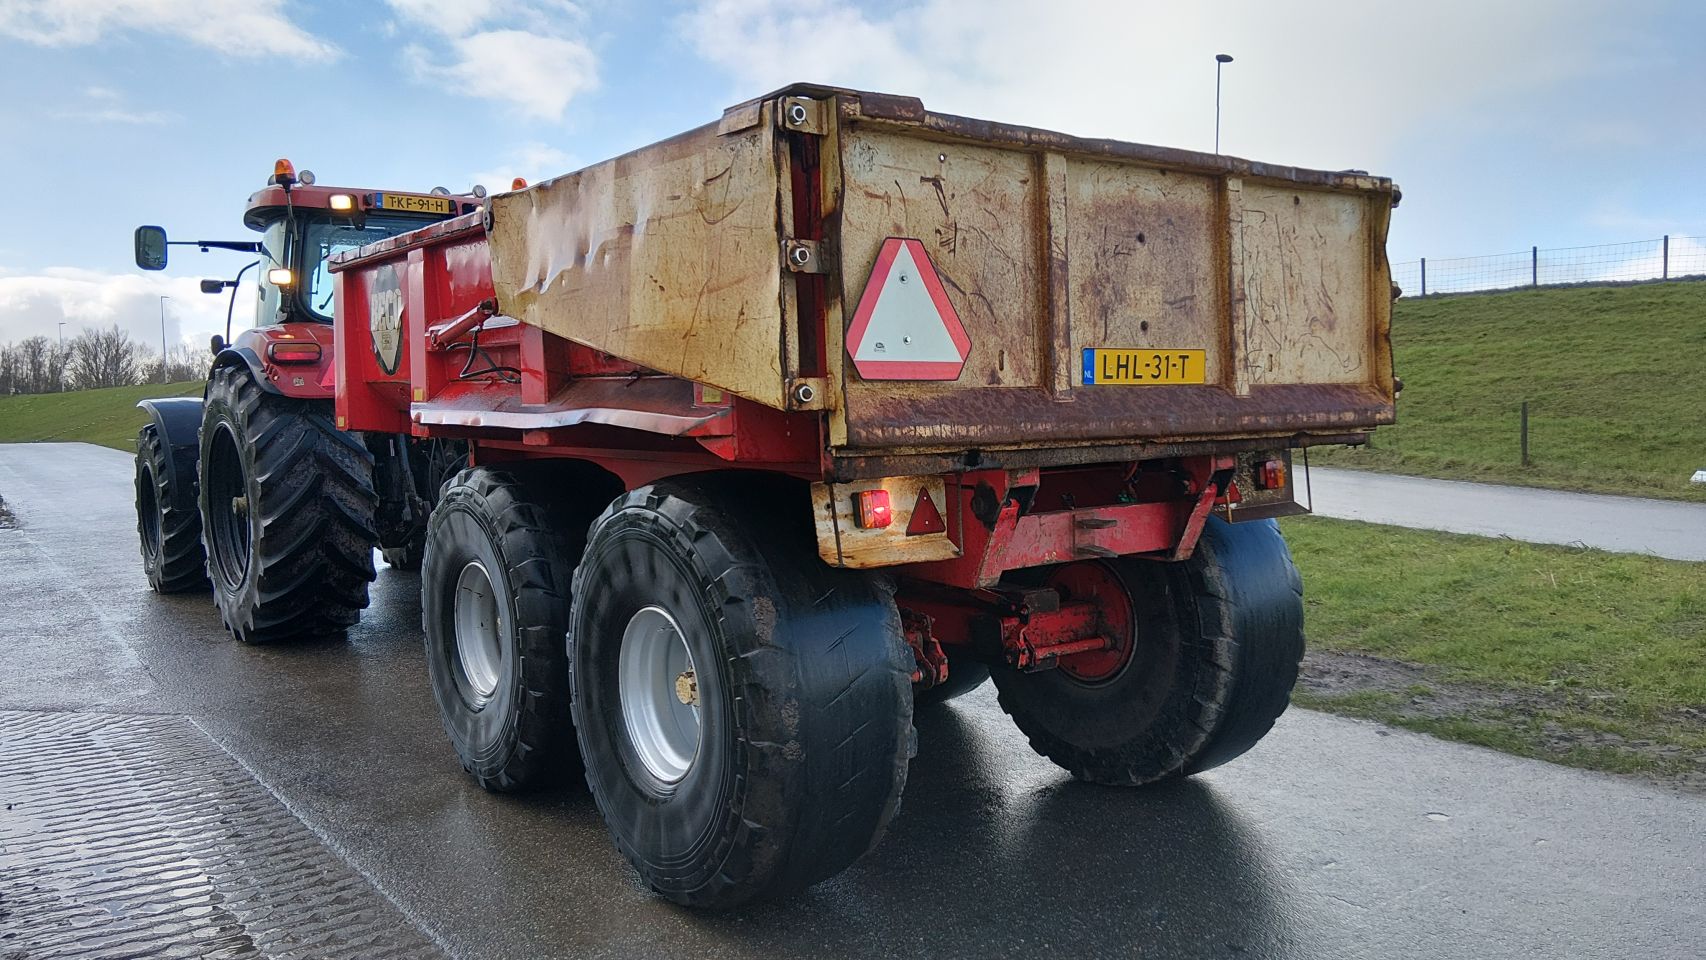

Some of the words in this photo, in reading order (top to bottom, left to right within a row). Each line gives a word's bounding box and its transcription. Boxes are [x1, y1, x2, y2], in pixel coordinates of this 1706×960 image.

[389, 196, 443, 211] TKF-91-H
[1103, 354, 1190, 379] LHL-31-T
[1084, 370, 1093, 379] NL
